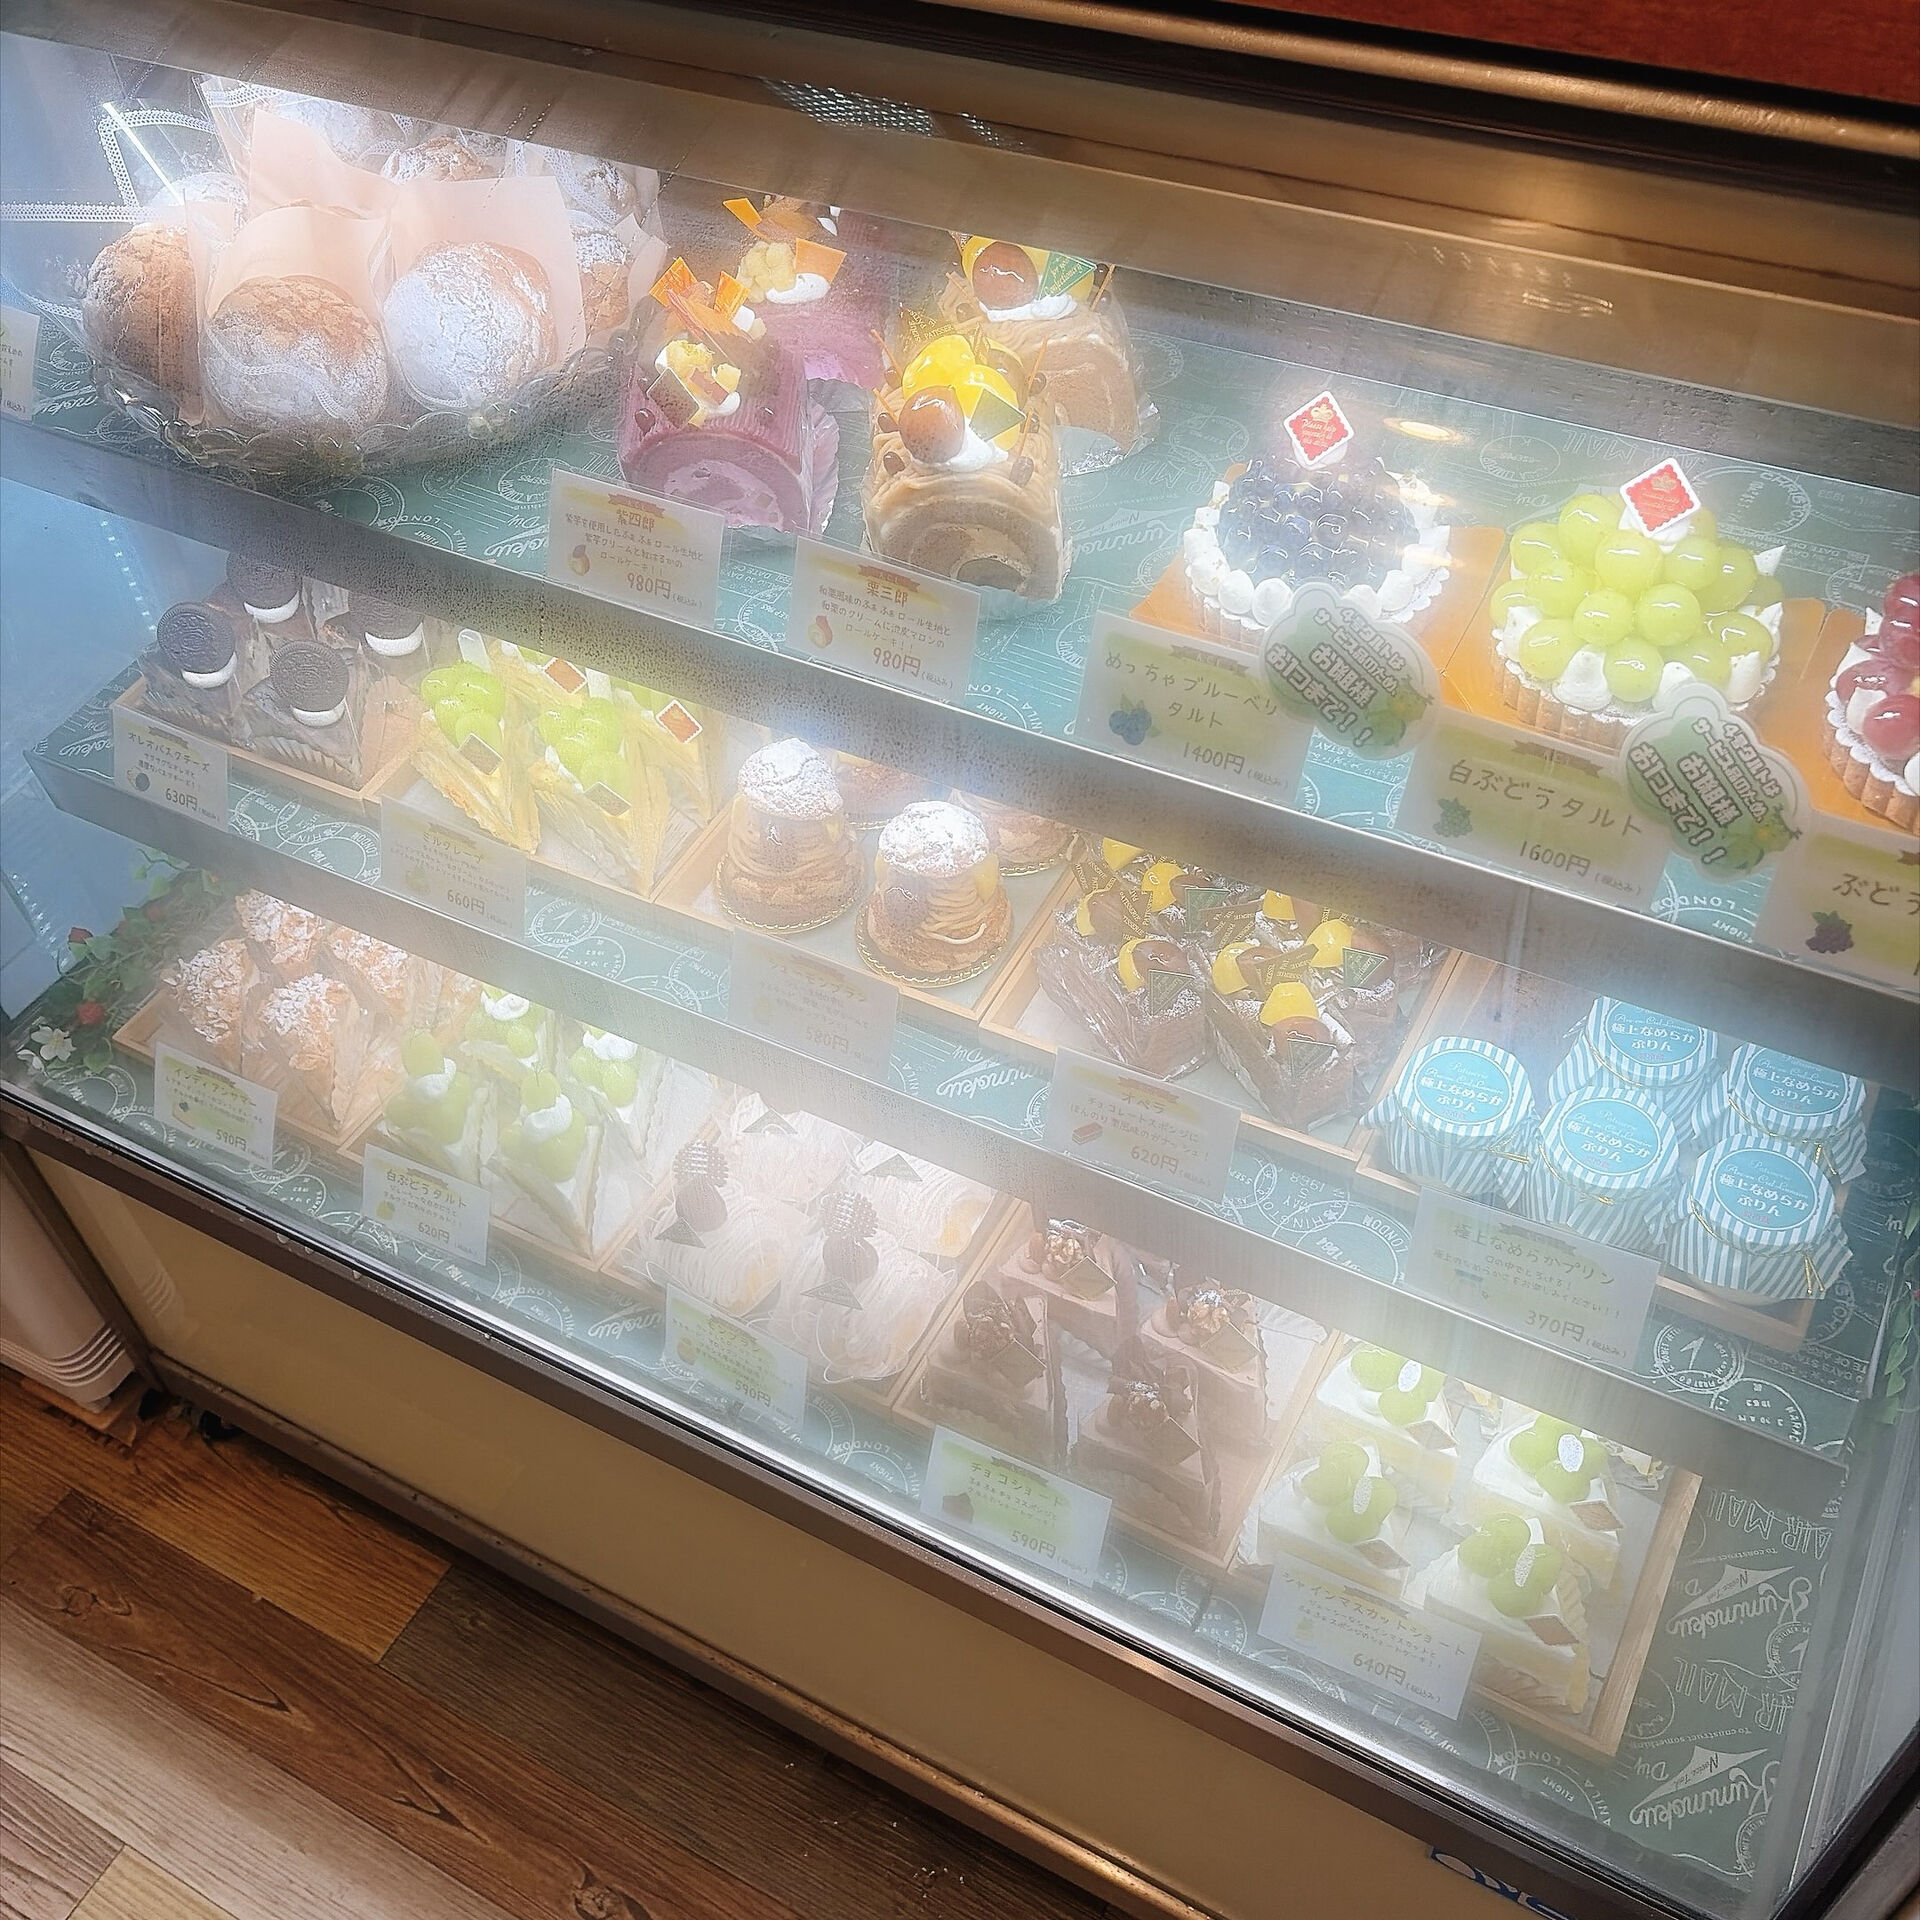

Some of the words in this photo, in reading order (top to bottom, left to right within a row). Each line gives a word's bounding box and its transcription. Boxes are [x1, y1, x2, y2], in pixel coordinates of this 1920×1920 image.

[626, 572, 671, 600] 980円
[866, 579, 909, 607] 栗三郎
[1340, 607, 1407, 671] 4号タルトは
[873, 647, 921, 676] 980円
[1168, 701, 1224, 728] タルト
[128, 731, 210, 773] オレオバスクチーズ
[1183, 742, 1245, 774] 1400円
[1723, 723, 1783, 798] 4号タルトは
[165, 788, 198, 811] 630円
[1449, 759, 1643, 837] 白ぶどうタルト
[1519, 840, 1591, 877] 1600円
[447, 890, 485, 916] 660円
[1610, 1023, 1696, 1044] 極上なめらか
[1420, 1076, 1503, 1106] 極上なめらか
[1752, 1067, 1840, 1101] 極上なめらか
[1121, 1091, 1166, 1114] オペラ
[215, 1129, 247, 1152] 590円
[1567, 1121, 1651, 1159] 極上なめらか
[1130, 1145, 1180, 1174] 620円
[386, 1169, 468, 1209] 白ぶどうタルト
[1719, 1173, 1809, 1211] 極上なめらか
[417, 1222, 450, 1244] 620円
[1361, 1213, 1408, 1253] LONDON
[1451, 1222, 1616, 1286] 極上なめらかプリン
[1524, 1310, 1585, 1342] 370円
[735, 1380, 771, 1408] 590円
[971, 1461, 1063, 1508] チョコショート
[1010, 1529, 1057, 1560] 590円
[1282, 1570, 1466, 1658] シャインマスカットショート
[1667, 1576, 1813, 1639] Kumimoku
[1353, 1652, 1406, 1686] 640円
[1629, 1760, 1782, 1830] Kumimoku
